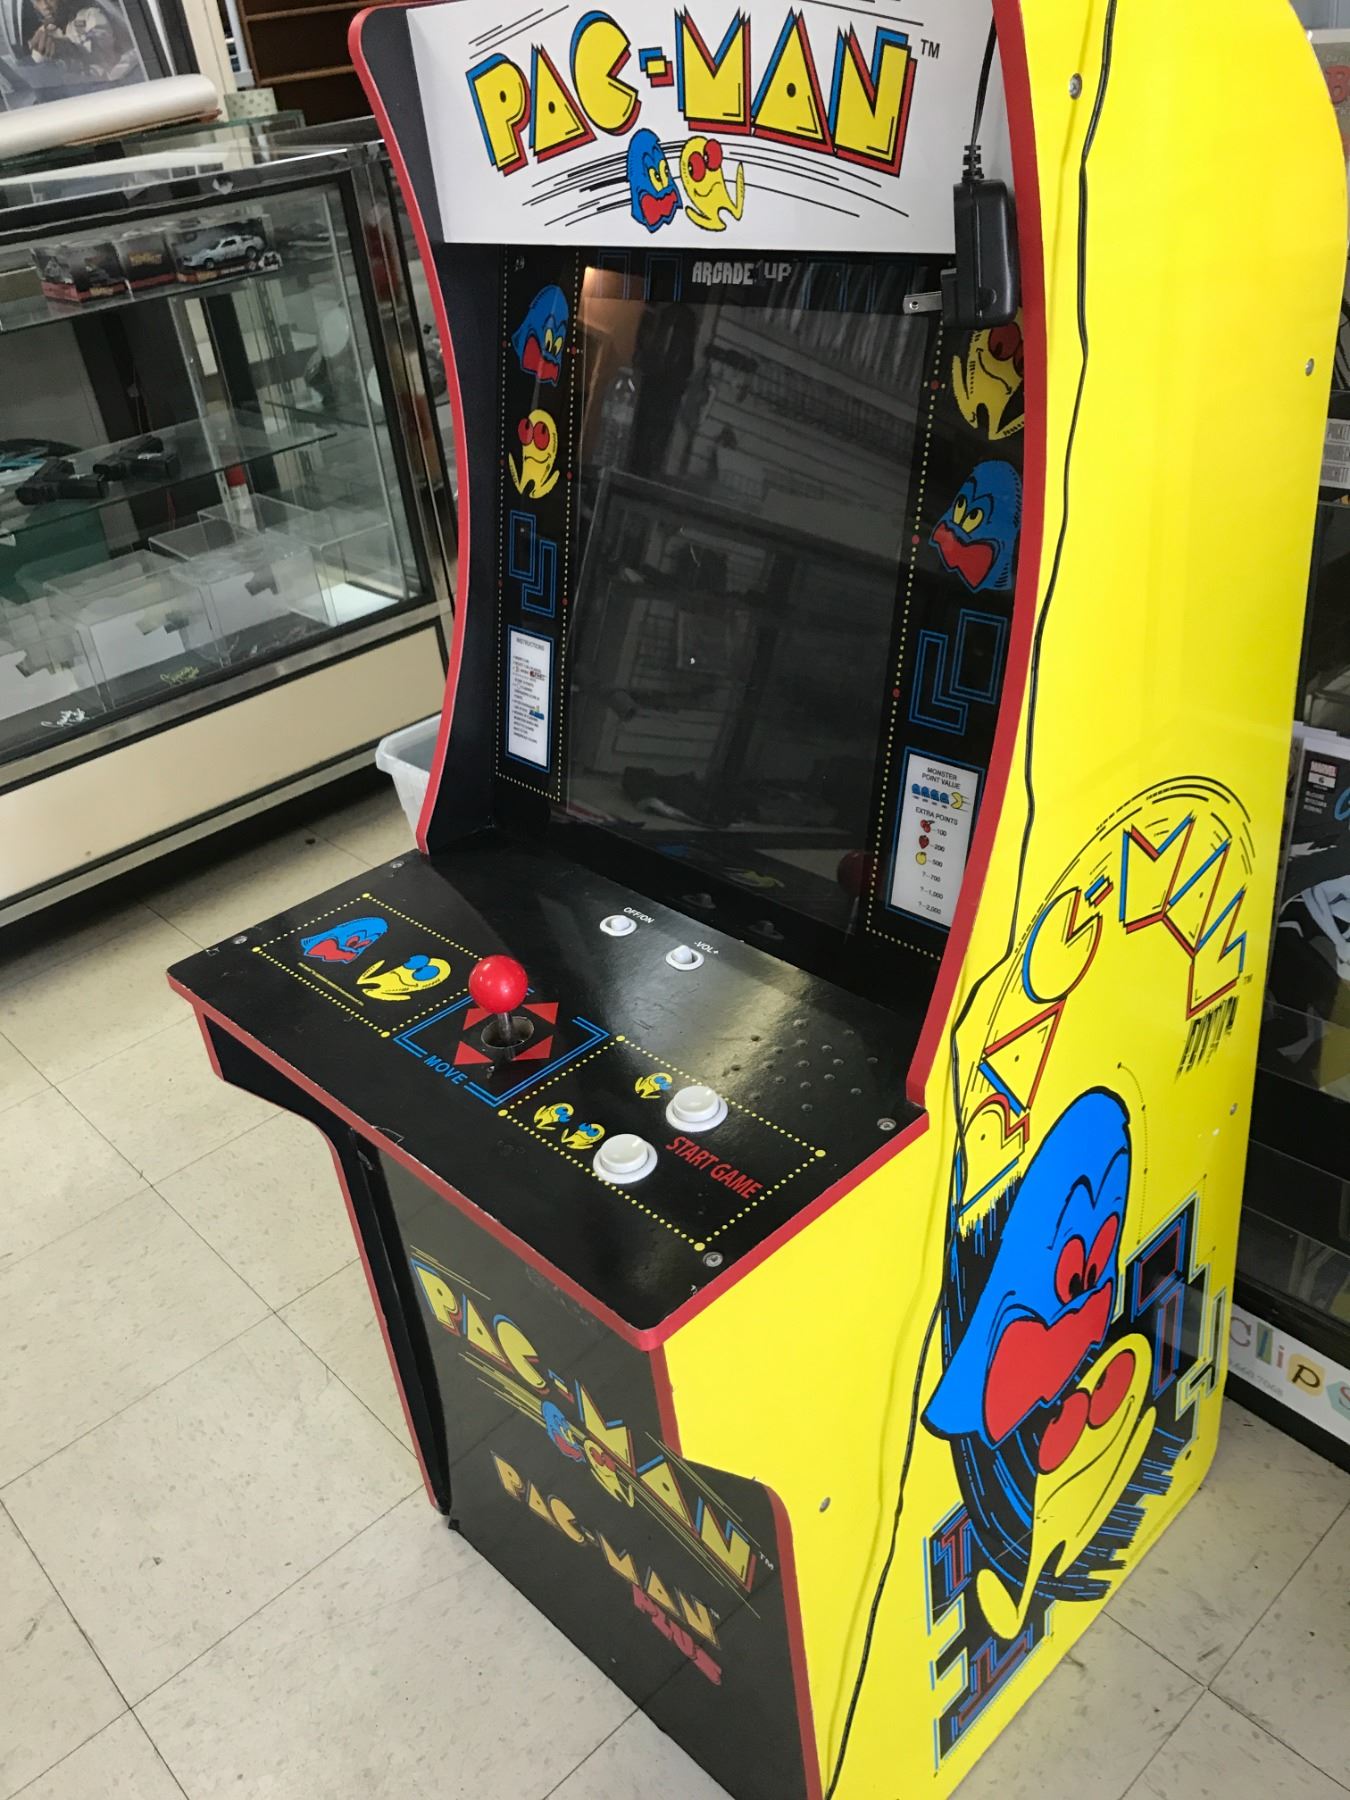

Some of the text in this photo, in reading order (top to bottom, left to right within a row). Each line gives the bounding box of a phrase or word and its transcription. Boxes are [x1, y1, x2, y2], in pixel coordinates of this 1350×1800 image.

[465, 5, 941, 177] PAC-MAN TM
[921, 772, 961, 790] POINT VALUE
[926, 766, 958, 780] MONSTER
[914, 806, 958, 826] EXTRA POINTS
[623, 906, 655, 924] OFF/ON
[423, 1054, 469, 1085] MOVE
[665, 1135, 764, 1200] START GAME
[410, 1257, 757, 1593] PAC-MAN
[489, 1449, 721, 1651] PAC-MAN
